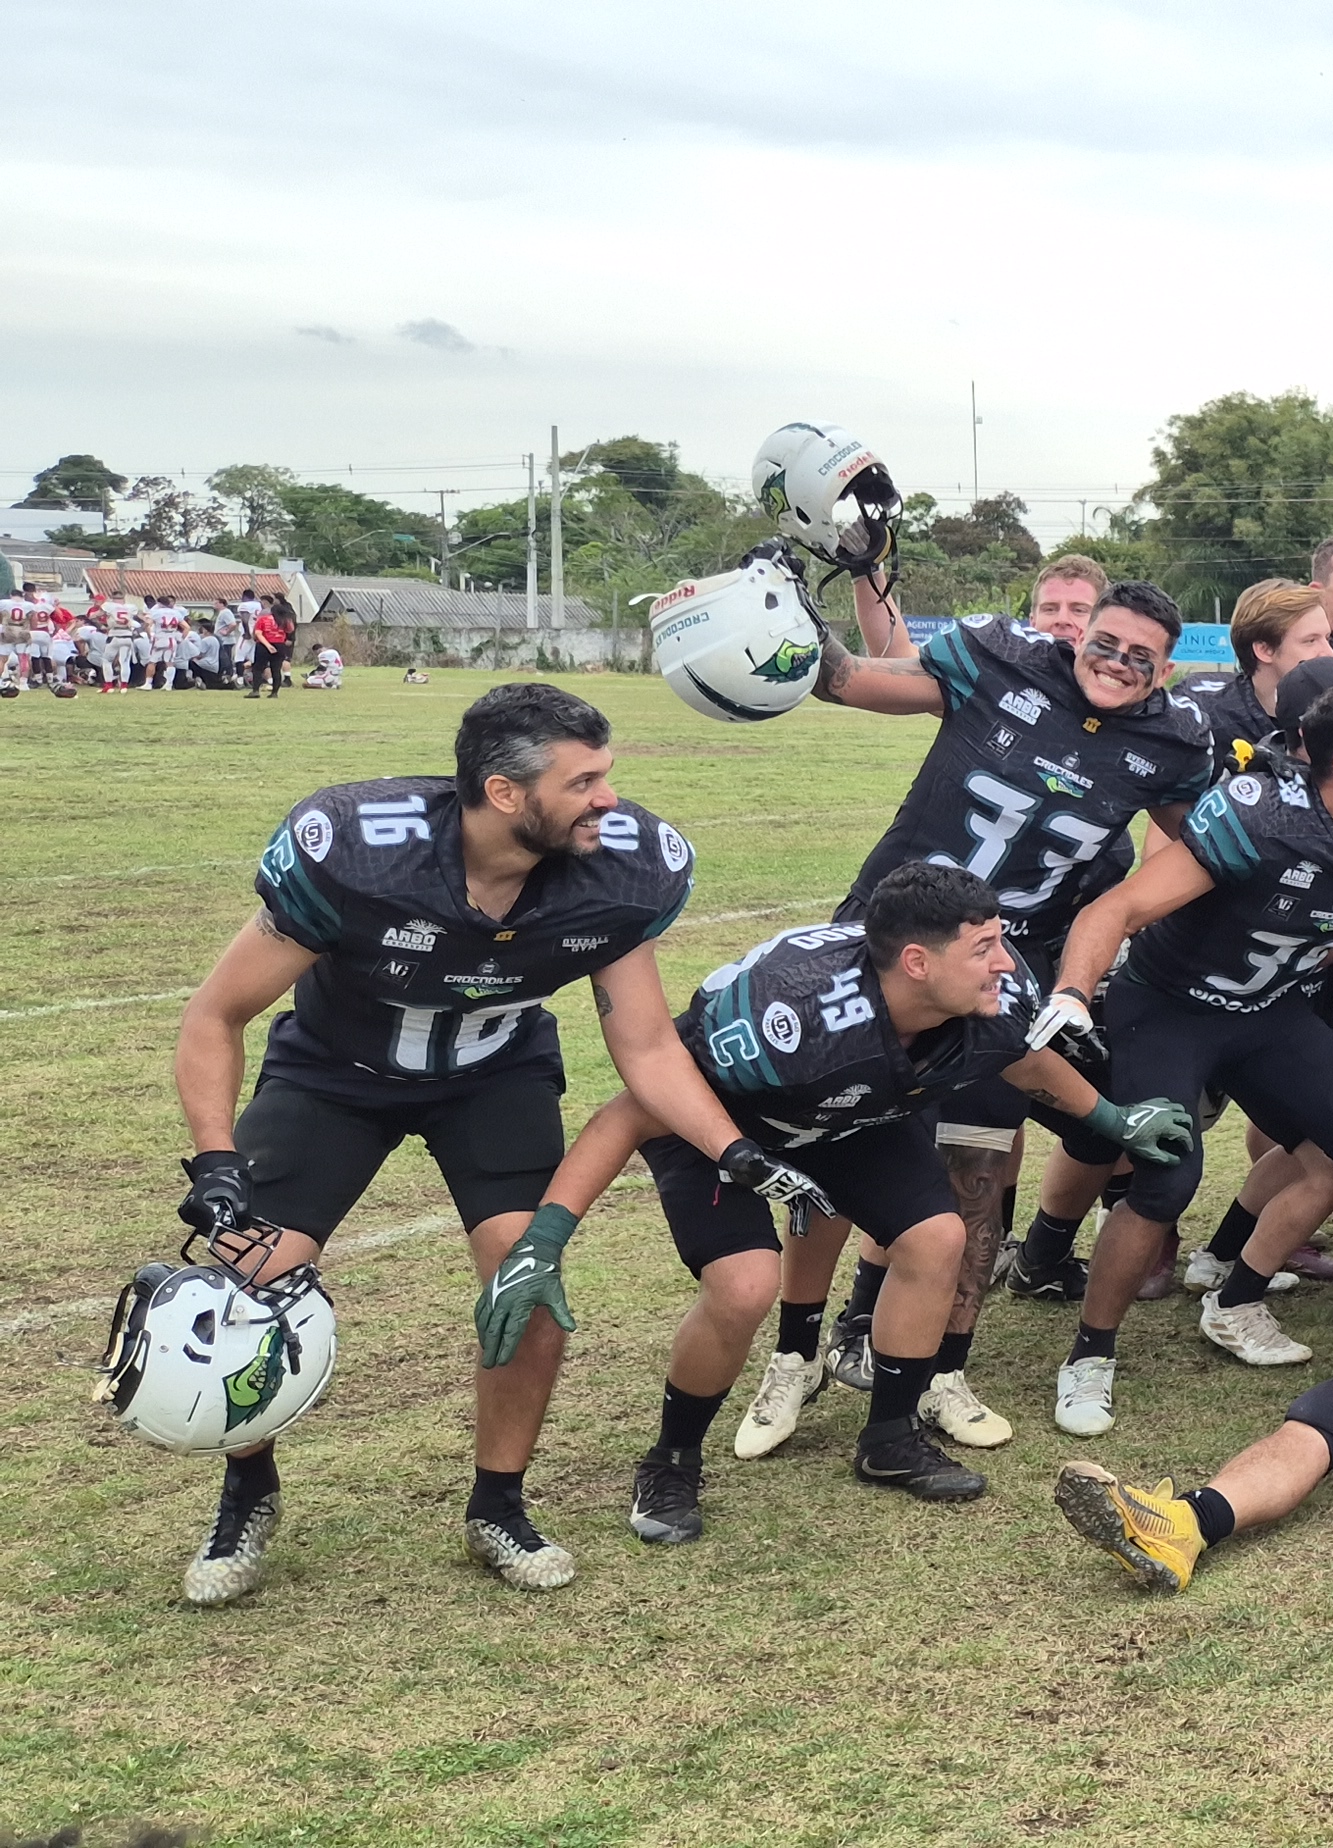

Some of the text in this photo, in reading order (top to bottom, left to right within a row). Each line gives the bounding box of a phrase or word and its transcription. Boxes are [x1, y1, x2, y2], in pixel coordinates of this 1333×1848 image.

[1001, 691, 1041, 719] ARBO
[357, 794, 433, 847] 16
[1283, 868, 1316, 883] ARBO
[384, 926, 437, 946] ARBO
[561, 936, 609, 948] OVERALL
[444, 973, 525, 986] CROCODILES
